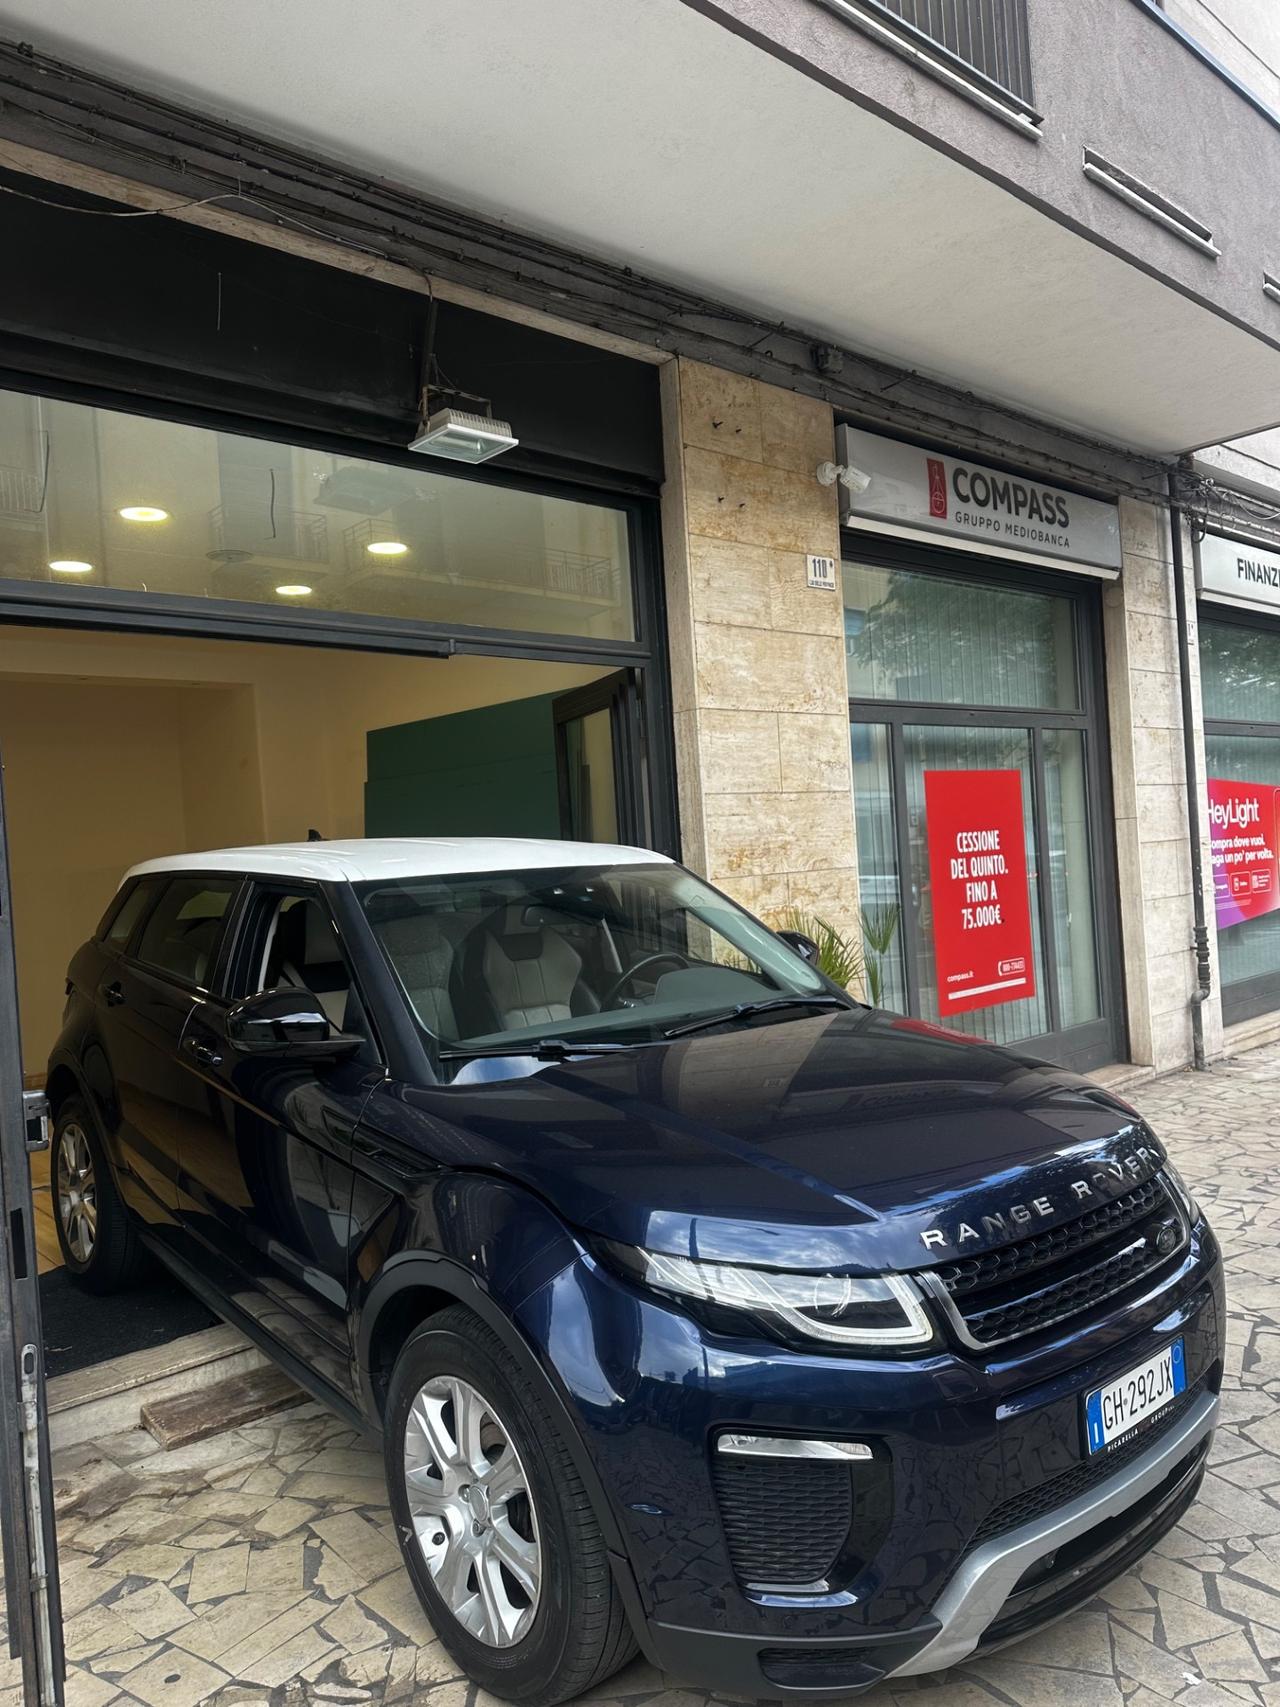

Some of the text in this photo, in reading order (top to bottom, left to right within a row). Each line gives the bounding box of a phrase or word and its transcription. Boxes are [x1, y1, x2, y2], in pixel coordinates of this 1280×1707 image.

[952, 467, 1070, 529] COMPASS
[955, 511, 1070, 548] GRUPPO MEDIOBANCA
[1237, 557, 1280, 588] FINANZ
[956, 829, 1000, 853] CESSIONE
[1211, 838, 1233, 852] ompra
[1233, 835, 1249, 848] dove
[950, 854, 1009, 880] DEL QUINTO.
[1225, 853, 1234, 863] un
[966, 879, 998, 904] FINO A
[961, 904, 1002, 930] 75.000€
[920, 1197, 1055, 1250] RANGE
